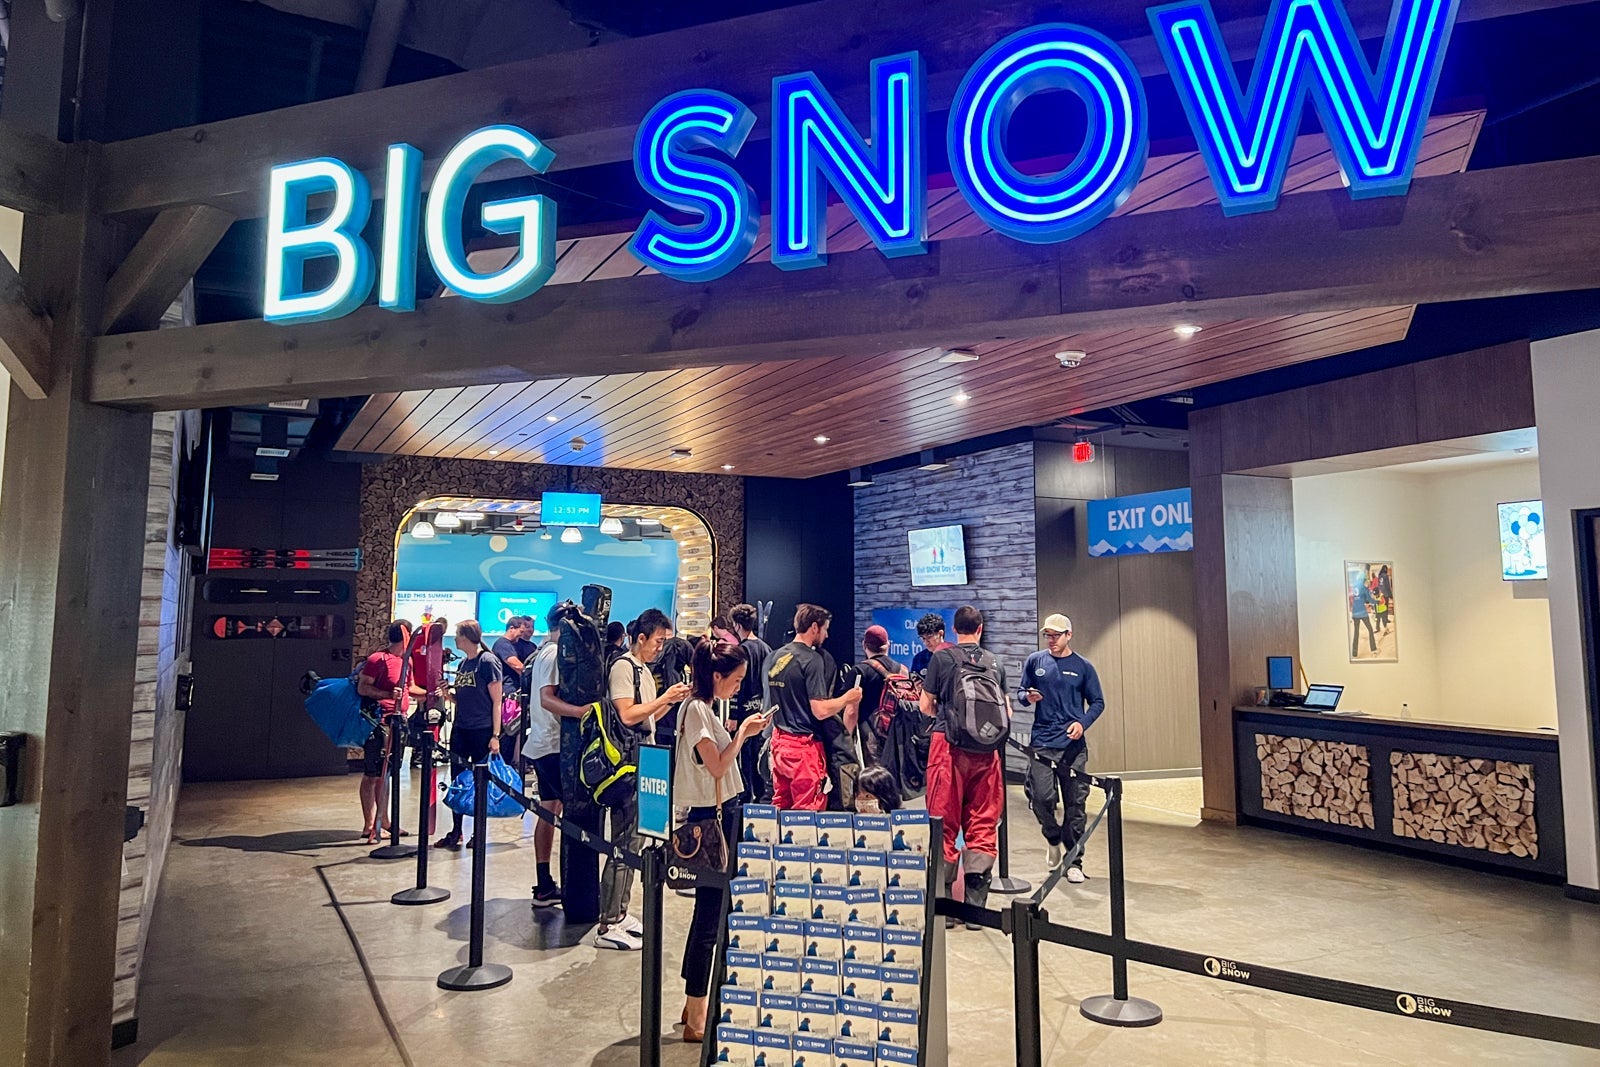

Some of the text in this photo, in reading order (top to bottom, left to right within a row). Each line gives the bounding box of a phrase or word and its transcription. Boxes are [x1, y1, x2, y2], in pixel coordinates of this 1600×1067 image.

[264, 0, 1460, 325] BIG SNOW
[1107, 502, 1193, 532] EXIT ONL
[888, 640, 922, 656] ime to
[640, 776, 668, 796] ENTER
[679, 872, 696, 880] SNOW
[1221, 960, 1236, 970] BIG
[1222, 968, 1250, 980] SNOW
[1417, 996, 1435, 1007] BIG
[1418, 1005, 1452, 1017] SNOW
